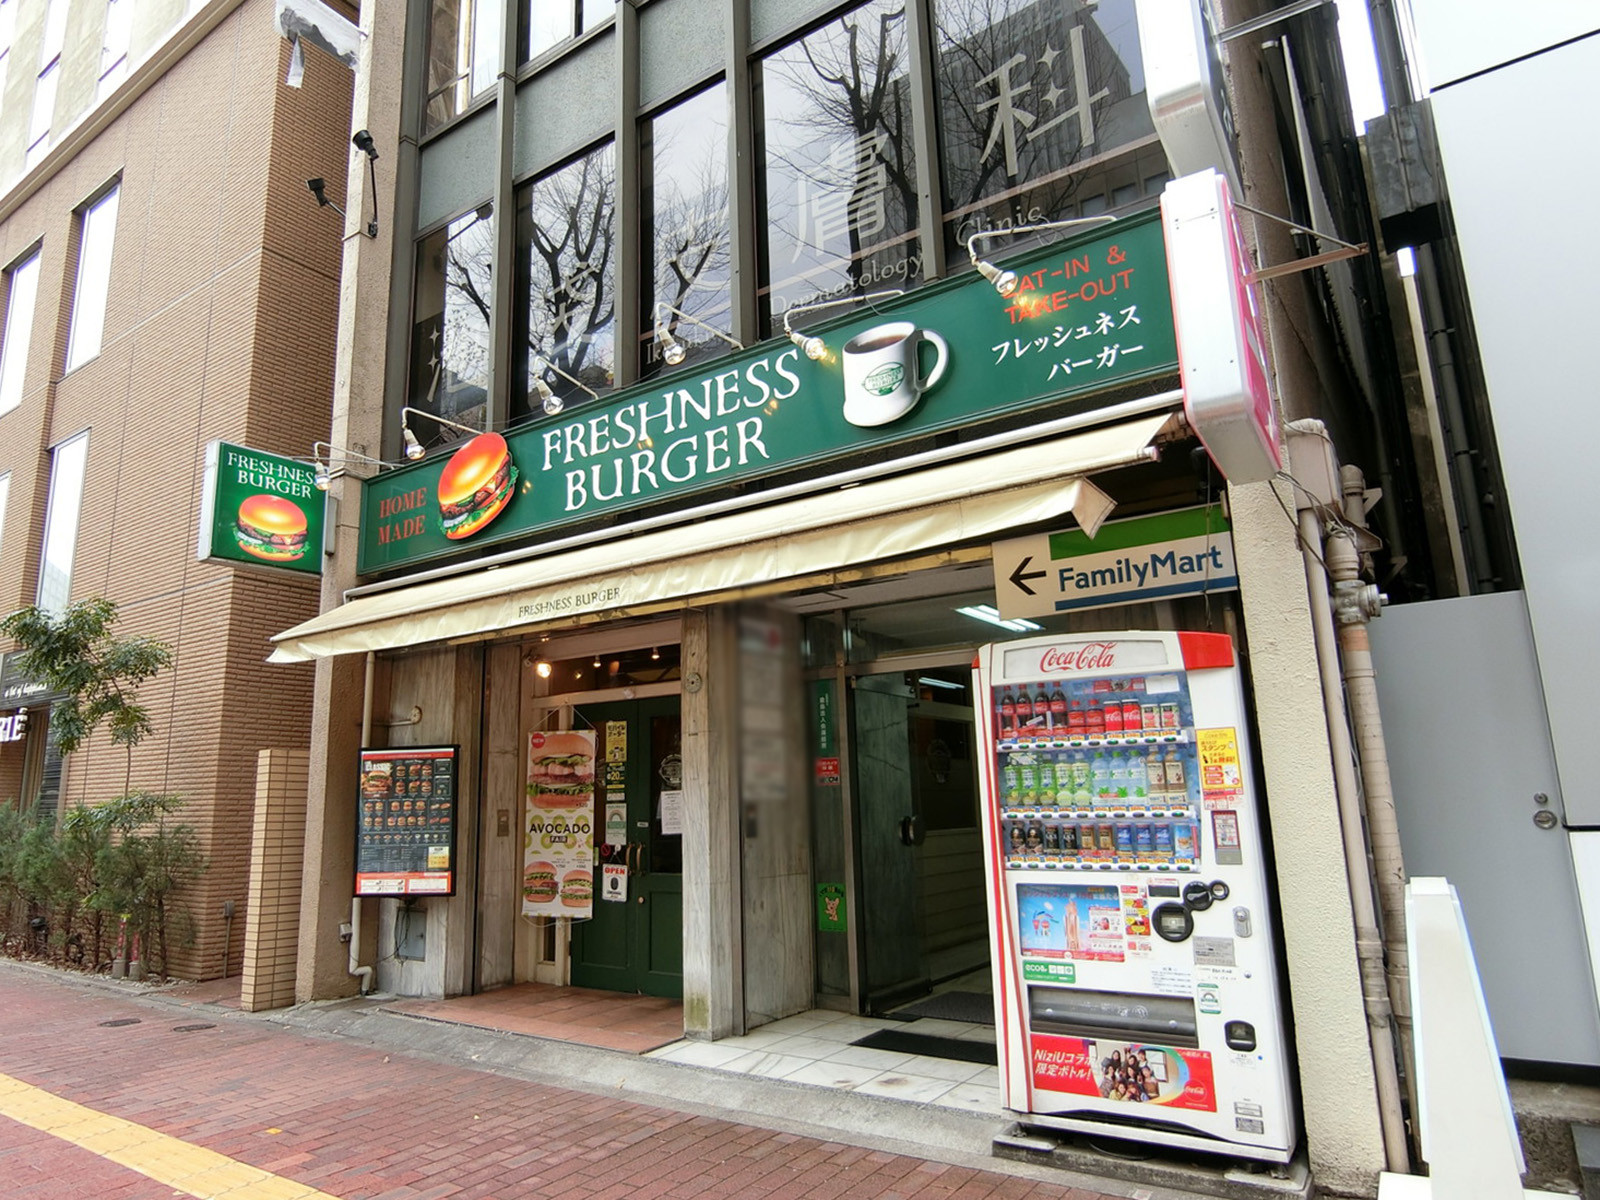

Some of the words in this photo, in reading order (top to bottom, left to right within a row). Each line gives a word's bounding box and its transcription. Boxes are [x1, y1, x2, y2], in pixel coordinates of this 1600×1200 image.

[956, 205, 1043, 247] Clinic
[1106, 245, 1126, 265] &
[1004, 268, 1135, 324] TAKE-OUT
[991, 305, 1141, 365] フレッシュネス
[1047, 343, 1144, 381] バーガー
[542, 349, 801, 471] FRESHNESS
[564, 416, 770, 511] BURGER
[237, 469, 312, 499] BURGER
[379, 487, 427, 519] HOME
[377, 515, 426, 546] MADE
[1058, 545, 1224, 592] FamilyMart
[518, 596, 573, 617] FRESHNESS
[575, 587, 621, 608] BURGER
[1039, 641, 1118, 673] Coca-Cola
[529, 823, 591, 834] AVOCADO
[604, 866, 626, 875] OPEN
